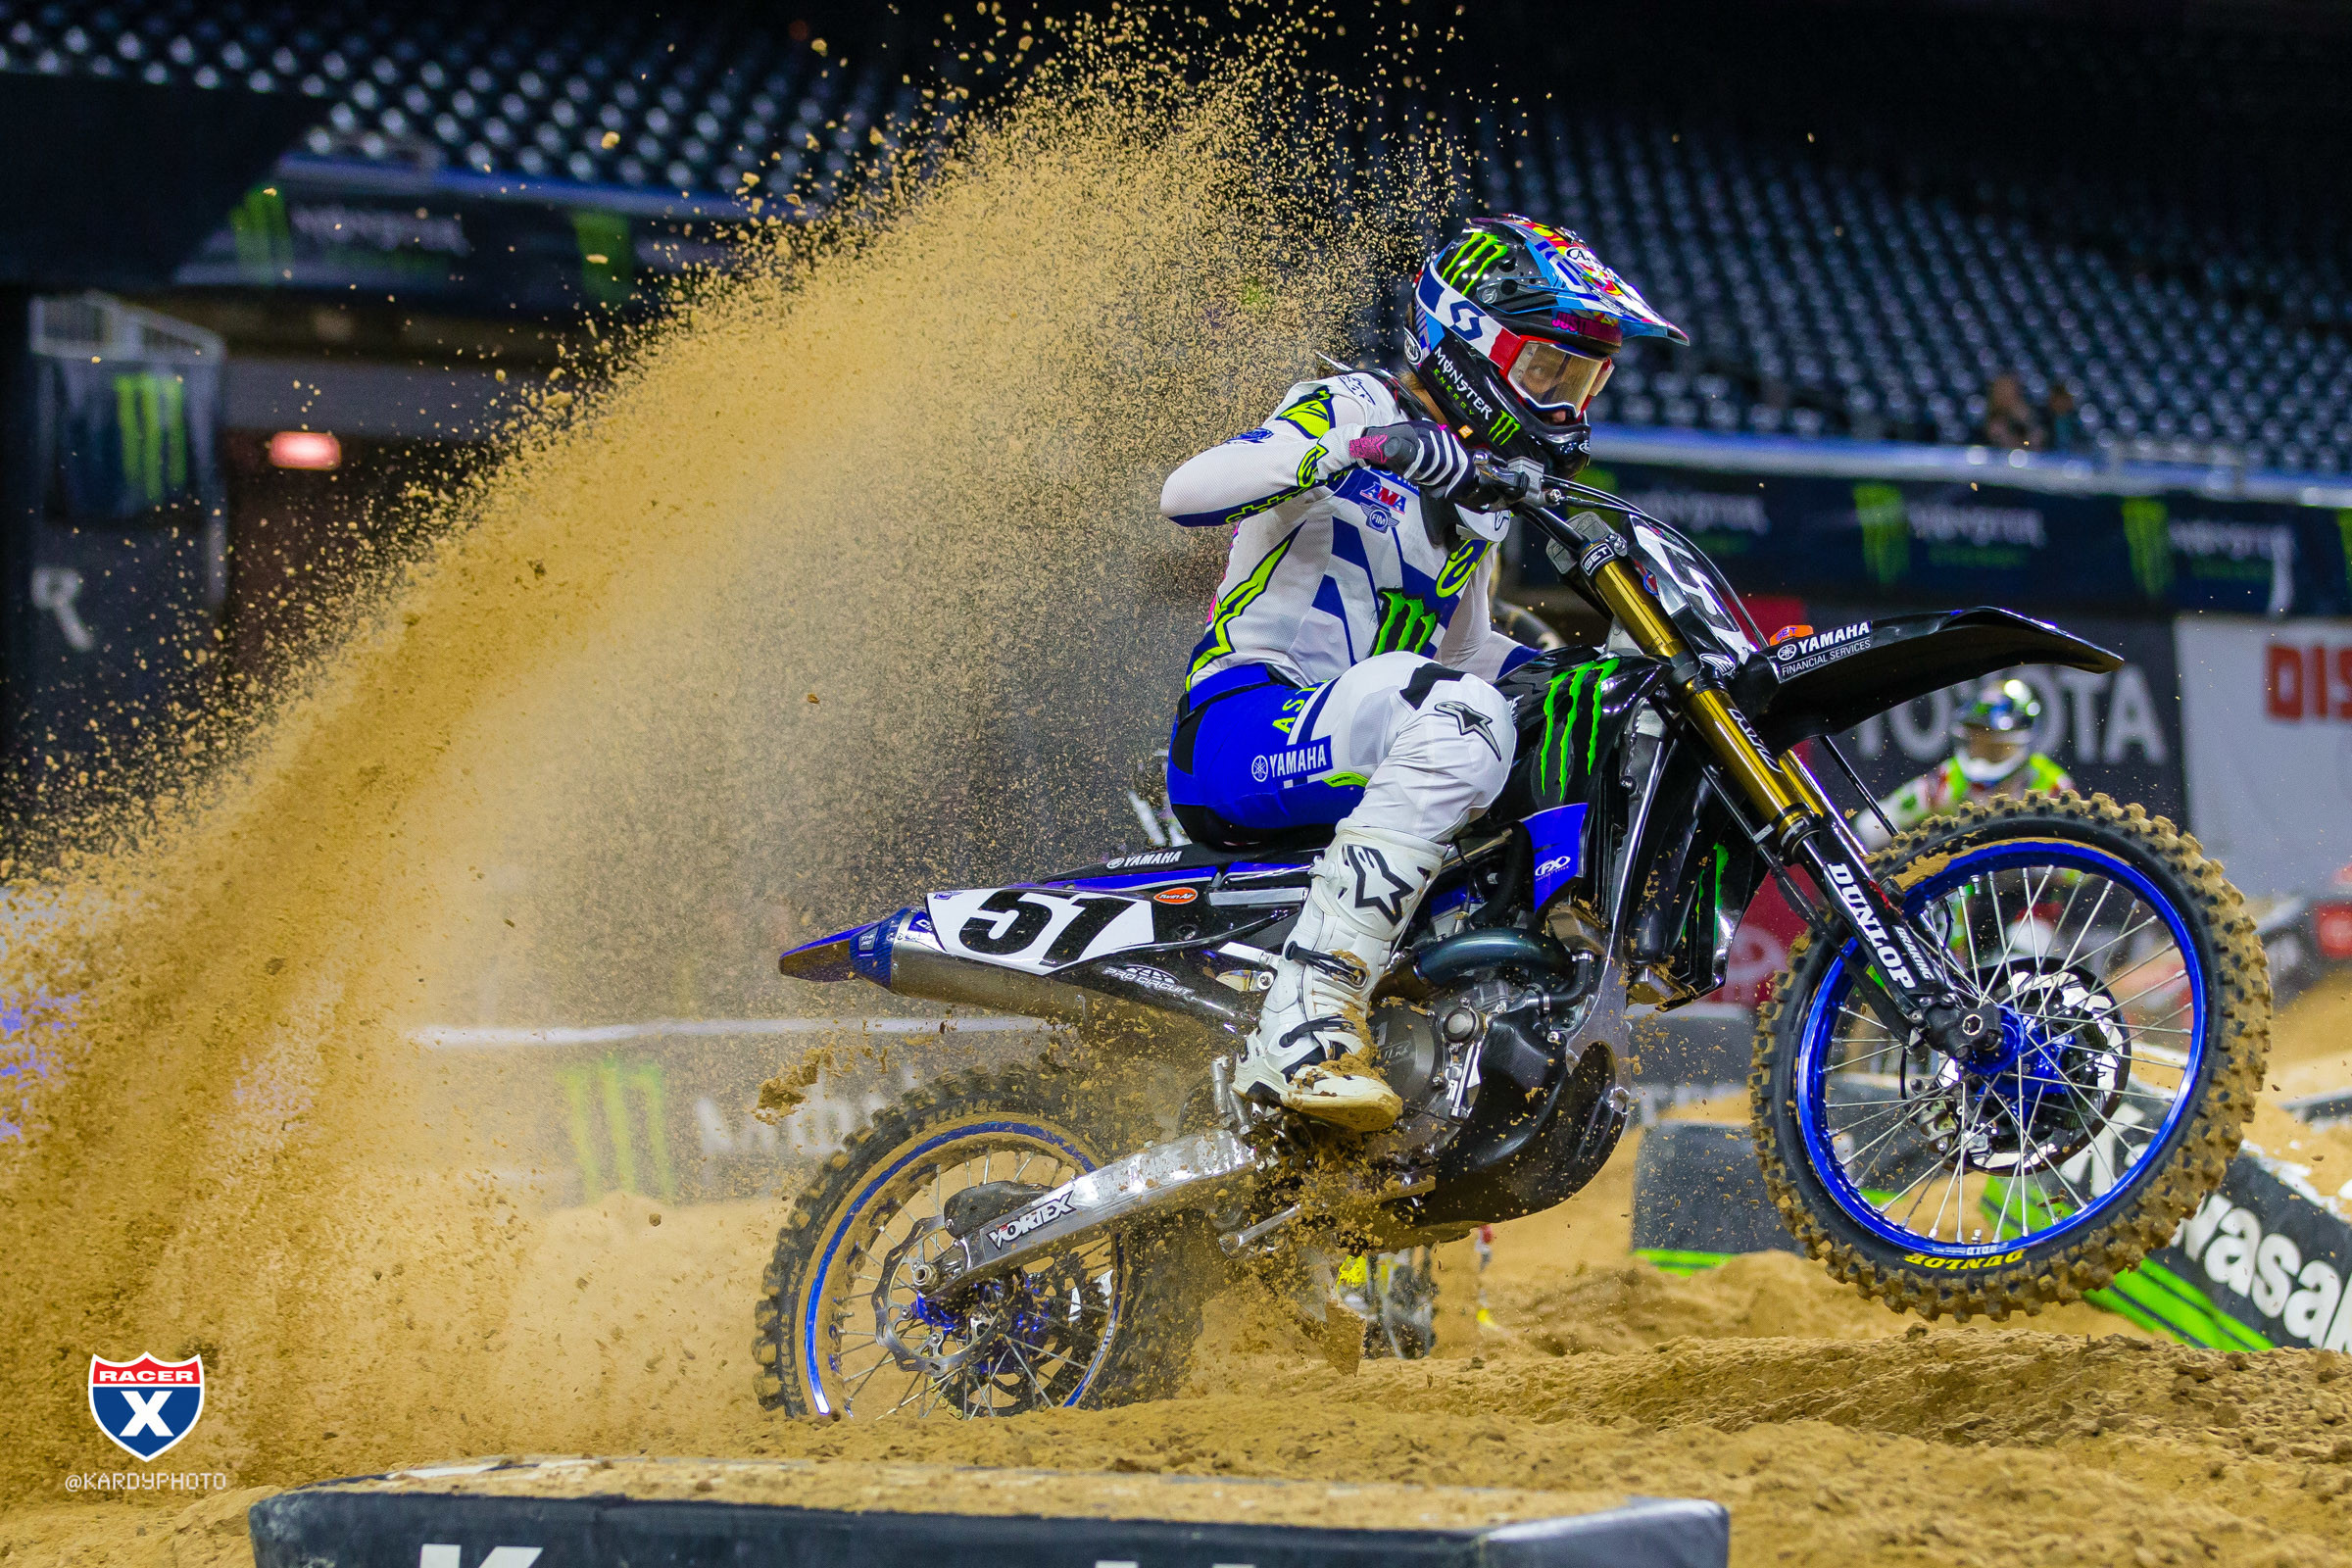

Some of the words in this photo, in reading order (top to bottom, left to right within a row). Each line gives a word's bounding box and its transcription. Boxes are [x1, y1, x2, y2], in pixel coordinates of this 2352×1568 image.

[1434, 346, 1494, 420] MONSTER
[1360, 481, 1406, 514] AMA
[1372, 514, 1387, 526] FIM
[1584, 546, 1608, 571] GET
[1776, 626, 1797, 641] GET
[1798, 621, 1871, 655] YAMAHA
[1782, 658, 1829, 676] FINANCIAL
[1830, 639, 1871, 661] SERVICES
[1269, 744, 1327, 778] YAMAHA
[1124, 851, 1182, 867] YAMAHA
[958, 889, 1137, 967] 51
[1827, 863, 1916, 989] DUNLOP
[1892, 925, 1935, 980] BRAKING
[1104, 967, 1137, 981] PRO
[1136, 976, 1195, 994] CIRCUIT
[988, 1192, 1075, 1251] VORTEX
[1904, 1250, 2026, 1270] DUNLOP
